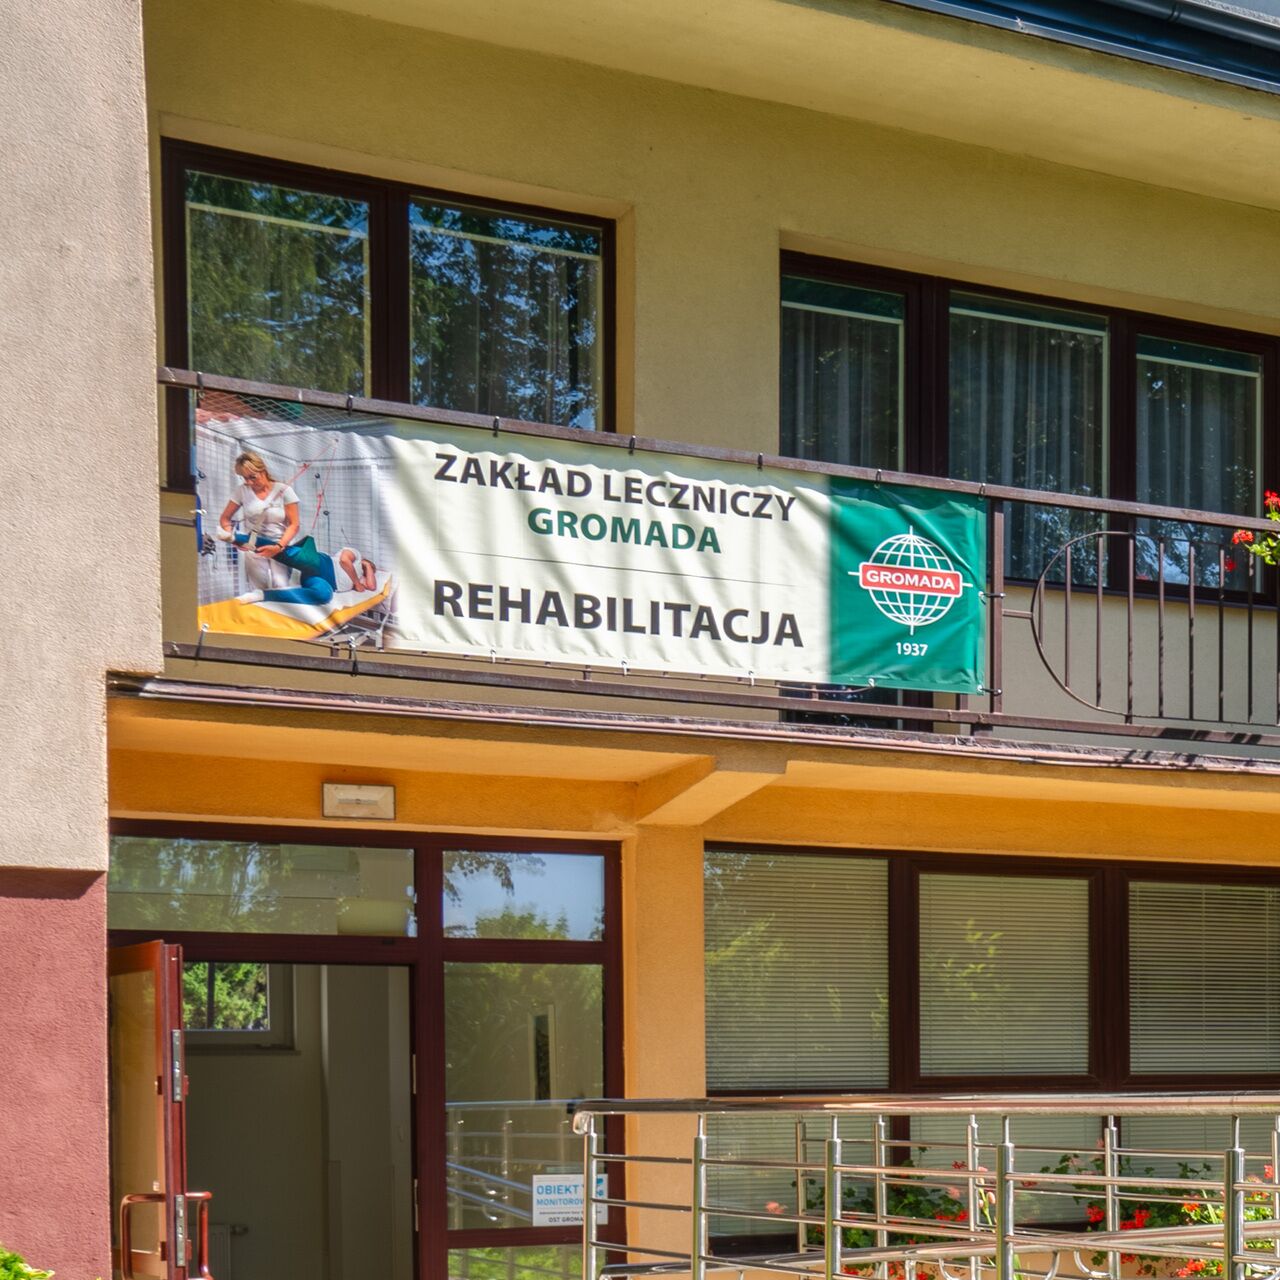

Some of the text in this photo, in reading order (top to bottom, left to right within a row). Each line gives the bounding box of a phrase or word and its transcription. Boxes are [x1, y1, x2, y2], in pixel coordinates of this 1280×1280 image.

[434, 453, 796, 522] ZAKŁAD LECZNICZY
[527, 507, 722, 554] GROMADA
[865, 569, 956, 591] GROMADA
[433, 579, 804, 648] REHABILITACJA
[896, 641, 928, 656] 1937
[536, 1184, 579, 1195] OBIEKT
